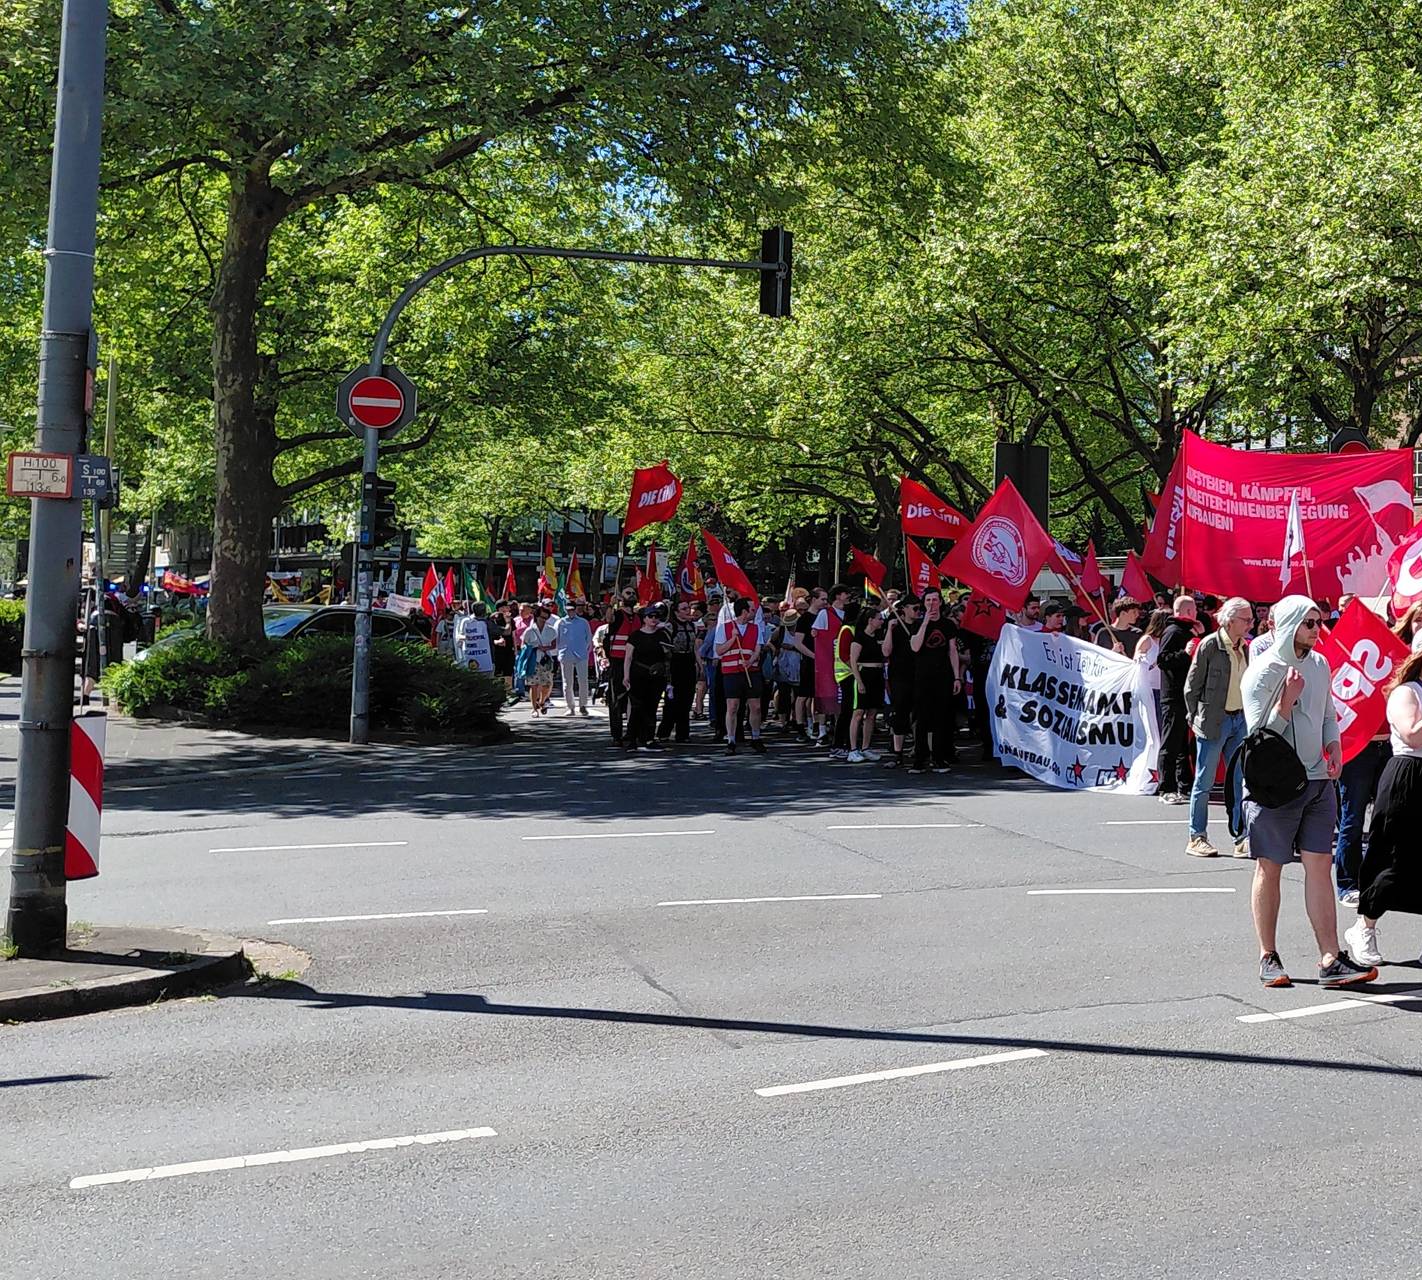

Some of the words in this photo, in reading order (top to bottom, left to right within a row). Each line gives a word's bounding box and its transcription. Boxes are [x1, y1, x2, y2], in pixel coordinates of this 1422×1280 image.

[1043, 641, 1057, 664] Es
[1059, 647, 1074, 671] ist
[994, 694, 1008, 720] &
